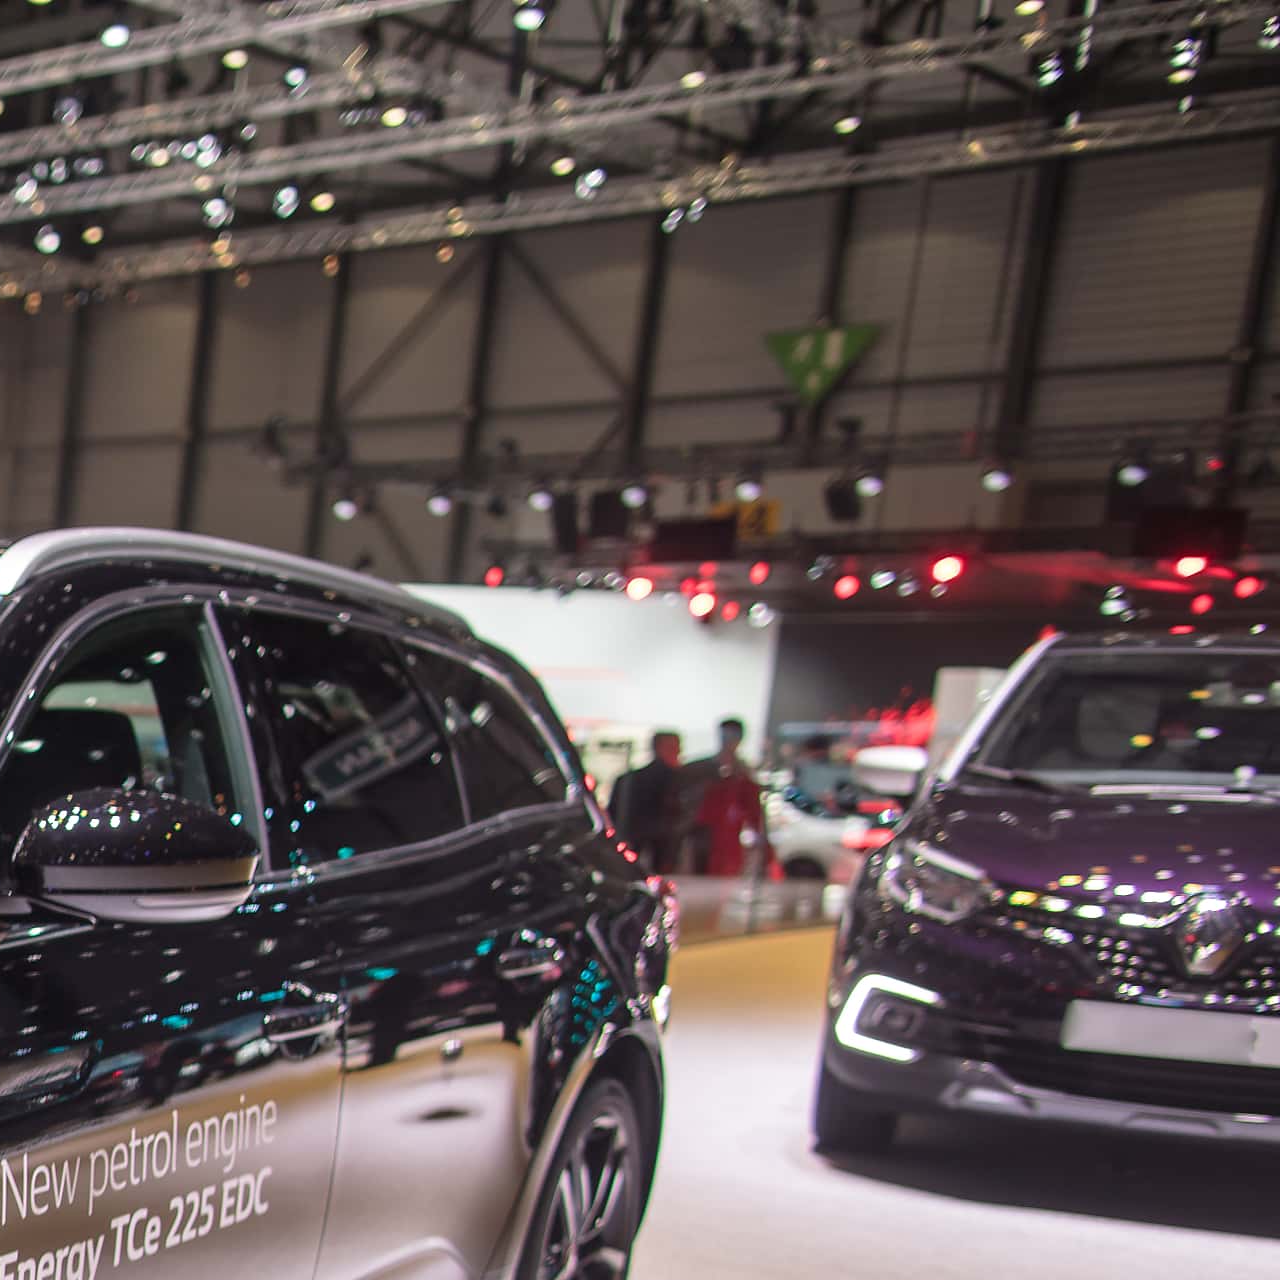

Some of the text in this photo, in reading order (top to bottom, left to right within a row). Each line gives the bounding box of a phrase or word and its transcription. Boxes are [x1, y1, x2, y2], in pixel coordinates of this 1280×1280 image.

[0, 1094, 278, 1226] New petrol engine
[110, 1206, 162, 1268] TCe
[165, 1185, 218, 1249] 225
[219, 1166, 273, 1229] EDC
